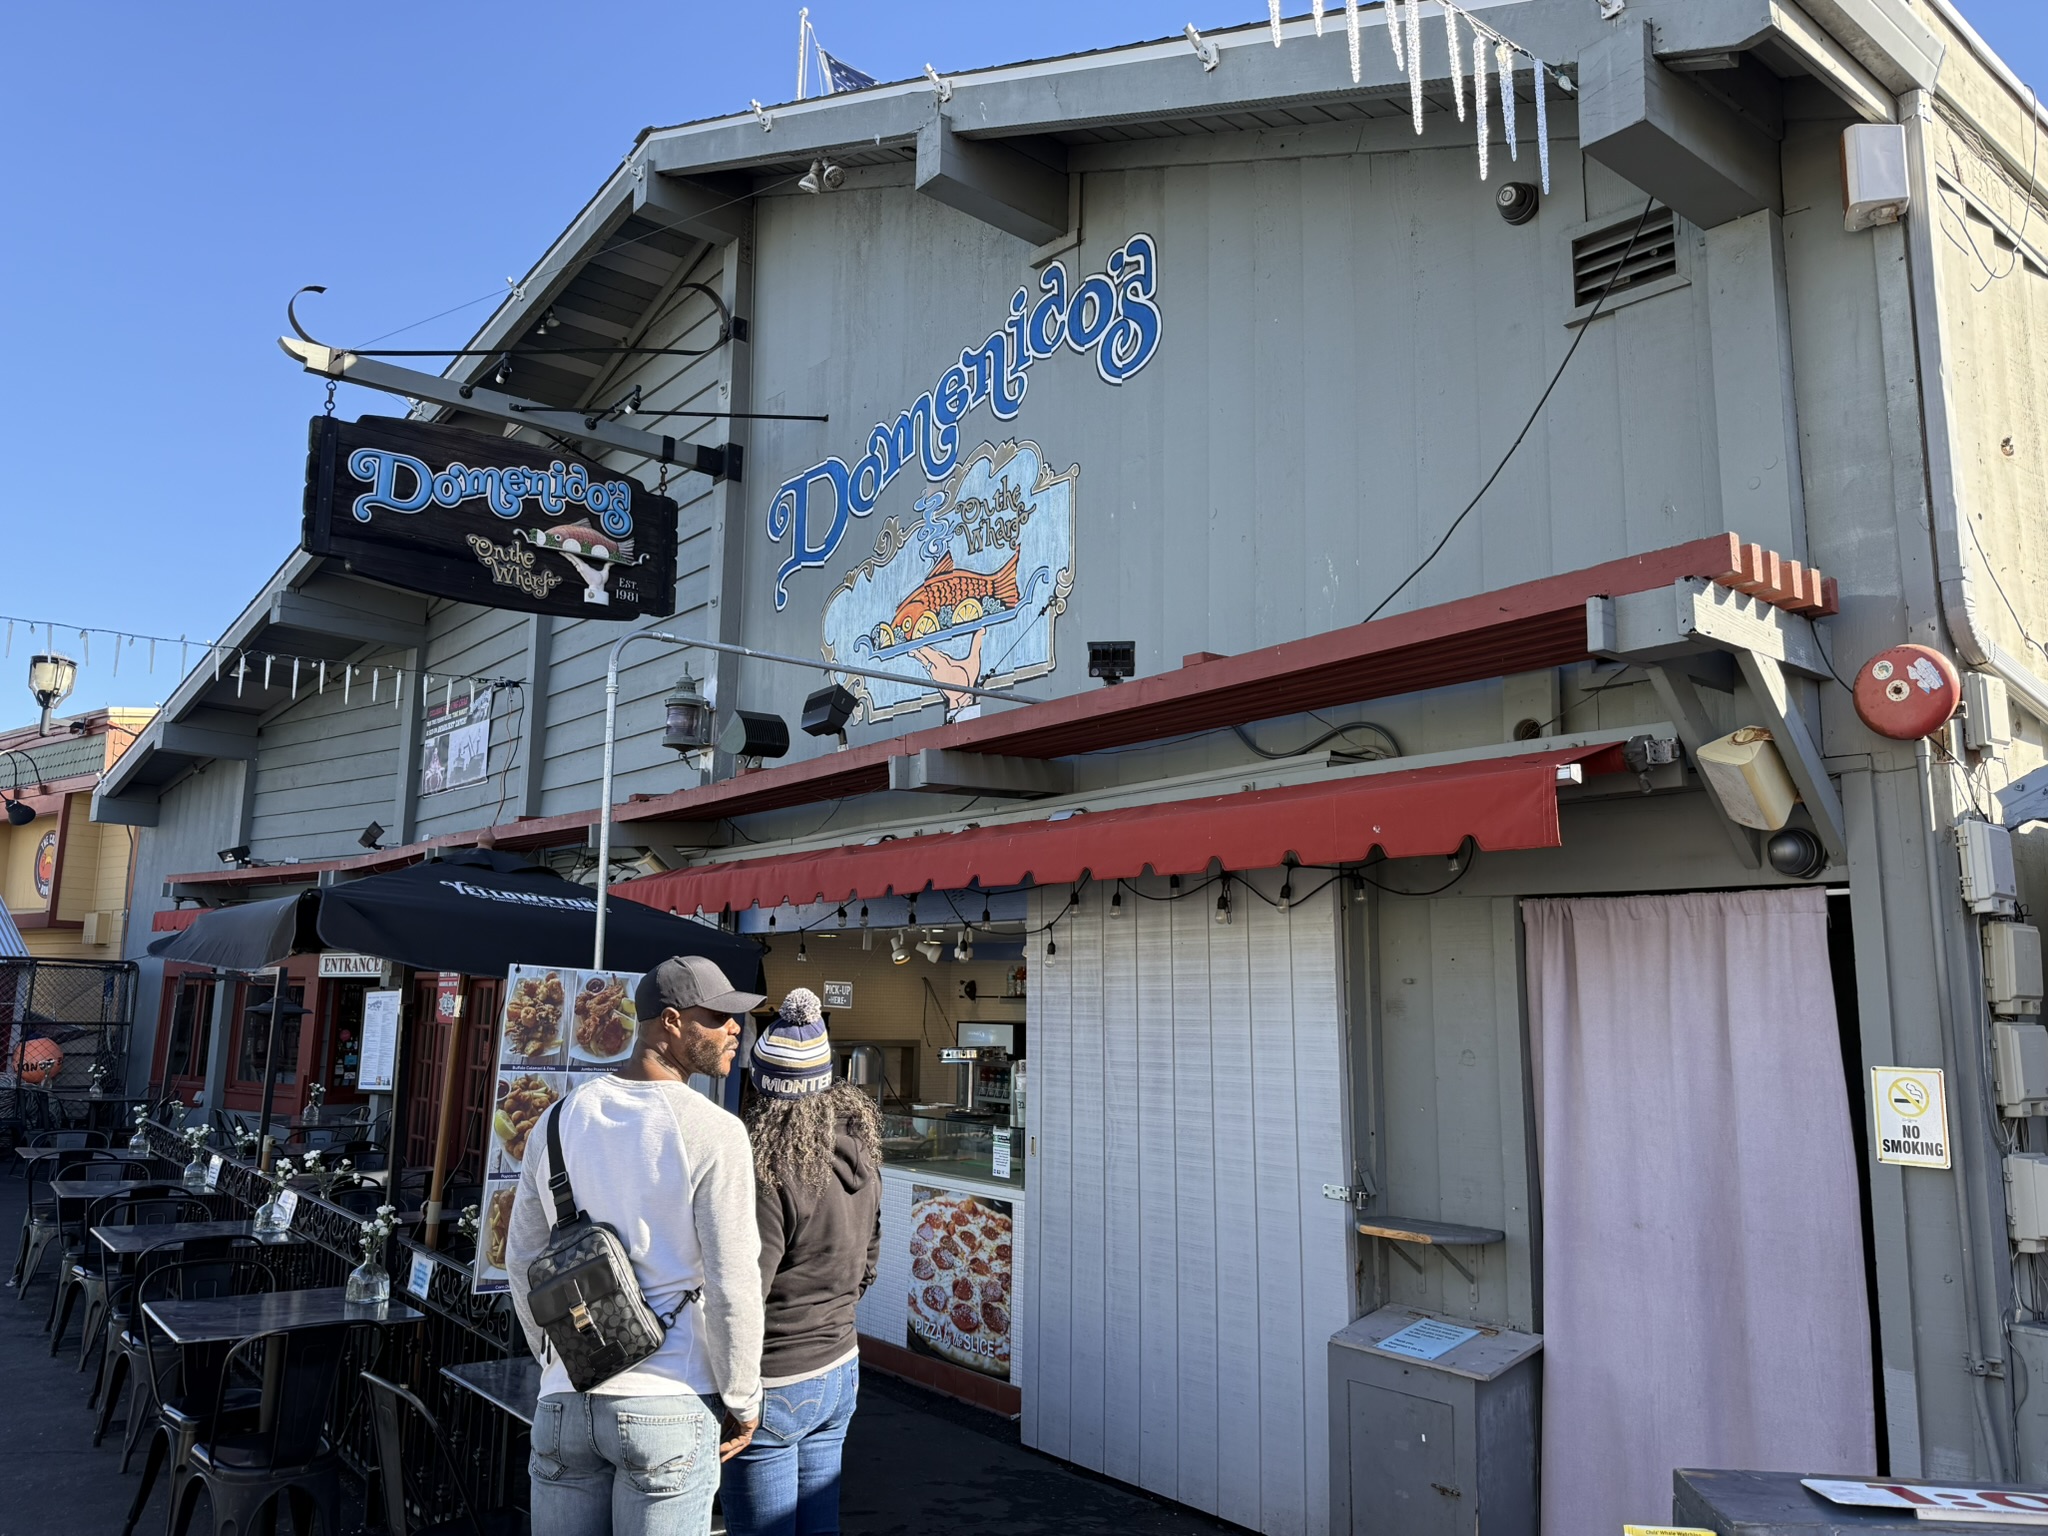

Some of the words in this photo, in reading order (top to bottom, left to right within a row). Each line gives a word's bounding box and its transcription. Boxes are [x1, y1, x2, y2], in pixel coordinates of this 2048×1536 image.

[767, 232, 1163, 612] Domenico's
[347, 447, 634, 539] Domenico's
[954, 492, 994, 523] On
[992, 475, 1022, 515] the
[953, 502, 1036, 556] Wharf
[465, 533, 510, 562] On
[509, 539, 536, 567] the
[483, 555, 562, 599] Wharf
[618, 576, 639, 591] EST.
[615, 588, 639, 603] 1981
[440, 880, 600, 910] YELLOWSTON
[323, 957, 381, 973] ENTRANCE
[1882, 1139, 1944, 1157] SMOKING
[1902, 1124, 1921, 1139] NO
[915, 1318, 943, 1342] PIZZA
[943, 1322, 953, 1349] by
[953, 1332, 963, 1348] the
[963, 1333, 995, 1359] SLICE
